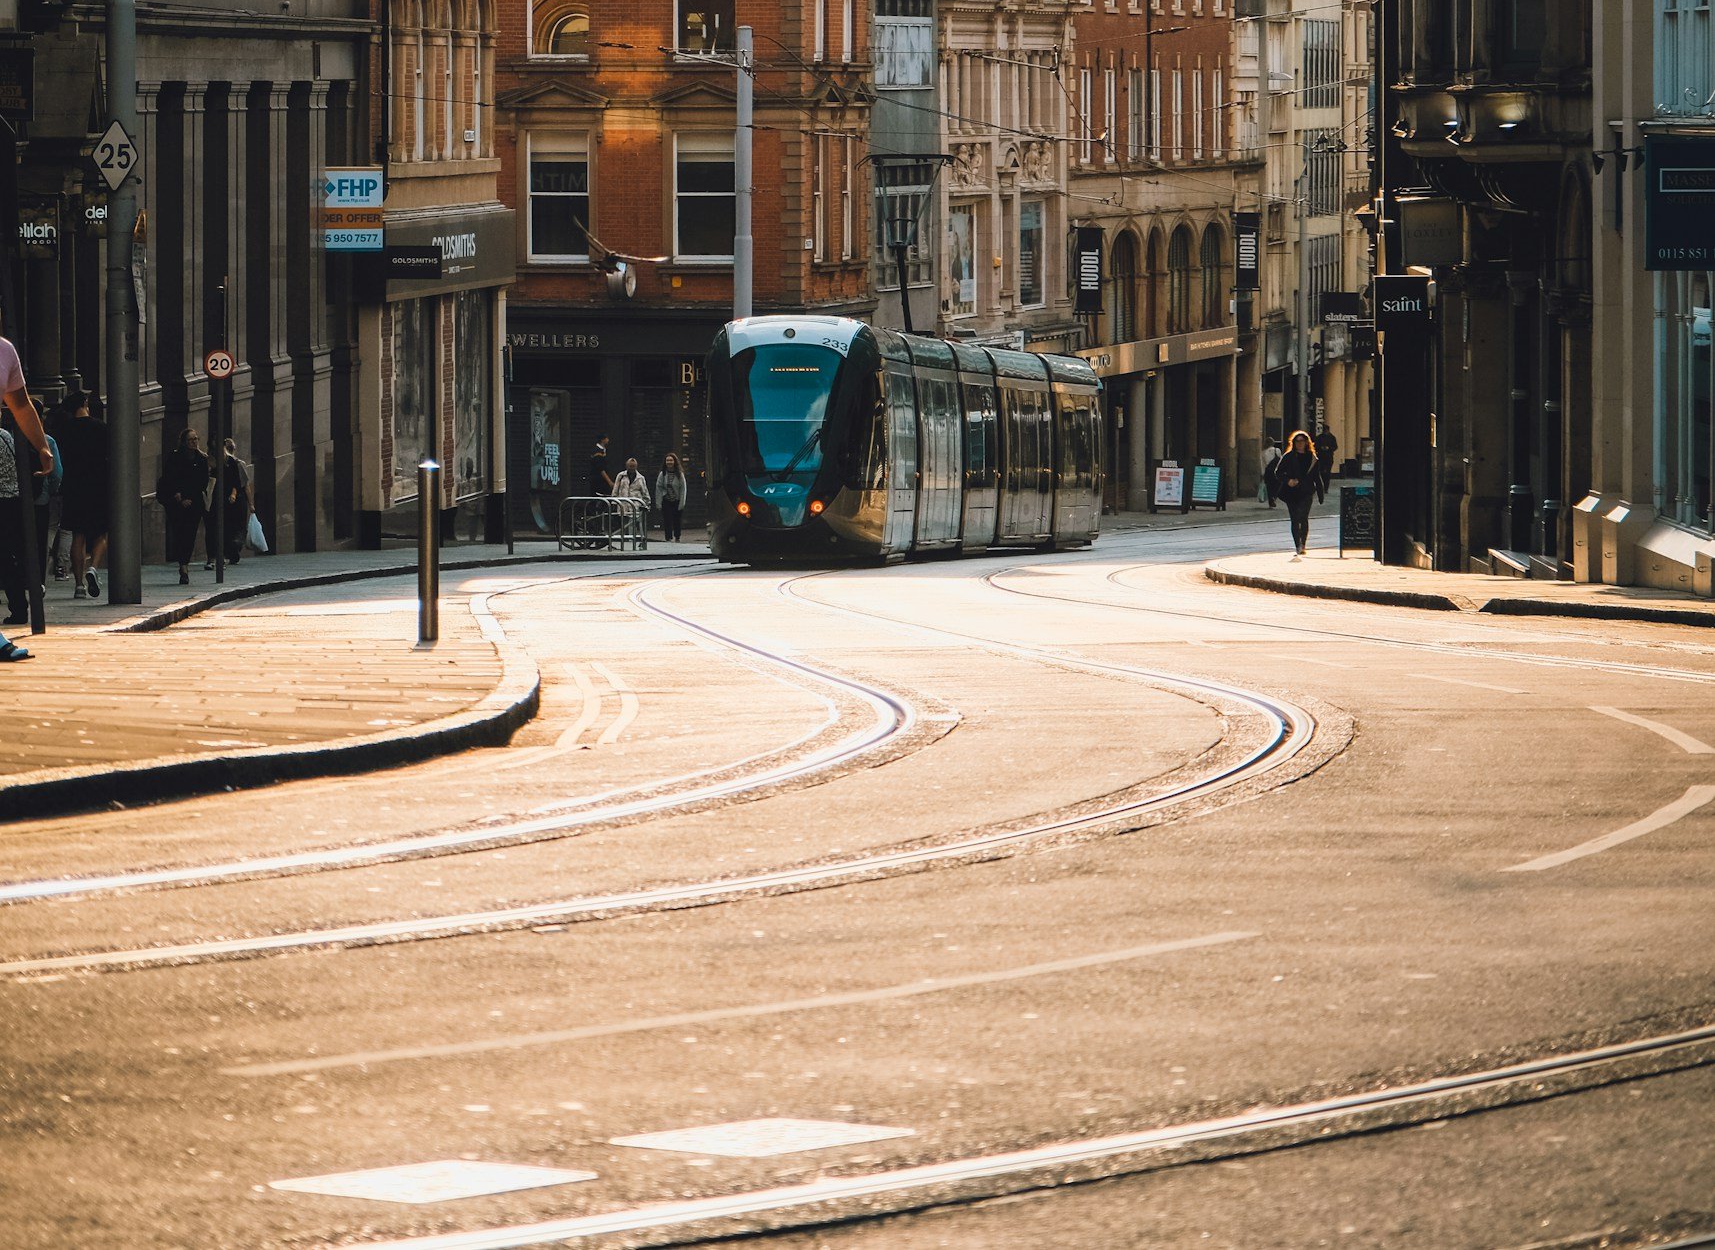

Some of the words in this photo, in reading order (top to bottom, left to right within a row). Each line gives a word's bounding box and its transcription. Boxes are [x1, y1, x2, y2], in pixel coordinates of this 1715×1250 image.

[101, 143, 131, 169] 25
[338, 179, 378, 197] FHP
[85, 205, 108, 219] del
[346, 214, 381, 223] OFFER
[333, 234, 353, 243] 950
[354, 234, 378, 243] 7577
[1239, 231, 1256, 269] HUDDL
[1658, 248, 1685, 259] 0115
[1688, 248, 1707, 259] 851
[1080, 248, 1099, 290] HUDDL
[1382, 295, 1422, 312] saint
[1325, 312, 1358, 322] slaters
[822, 337, 848, 352] 233
[210, 359, 230, 370] 20
[545, 443, 560, 455] FEEL
[545, 455, 559, 466] THE
